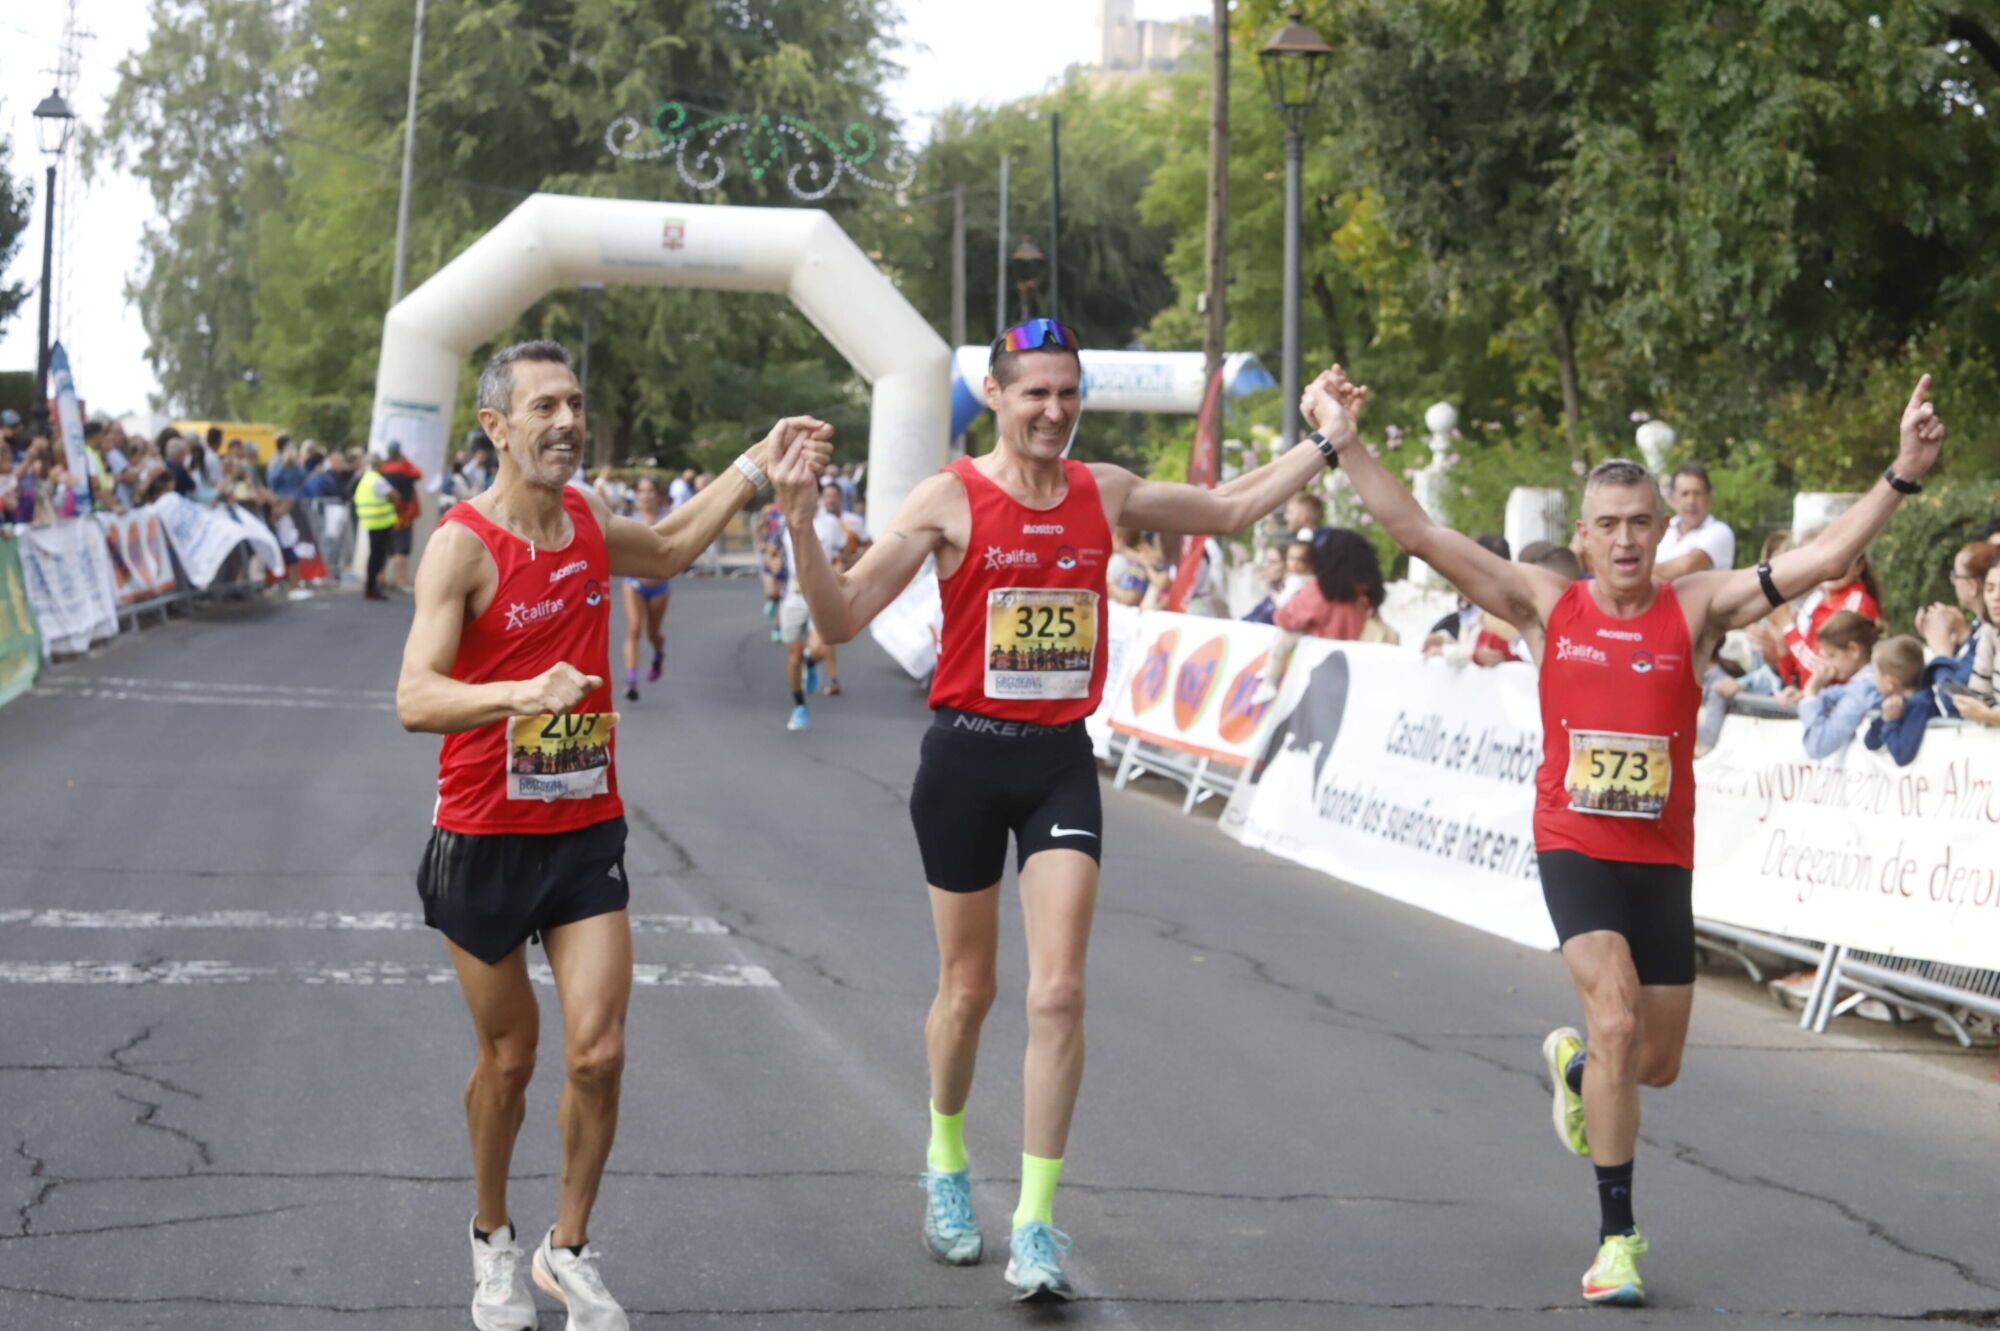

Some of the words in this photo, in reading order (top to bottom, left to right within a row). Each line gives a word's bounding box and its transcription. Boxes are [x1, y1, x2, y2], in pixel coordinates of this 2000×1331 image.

[998, 548, 1038, 564] califas
[521, 599, 564, 622] califas
[1015, 606, 1076, 638] 325
[1567, 643, 1607, 663] califas
[953, 713, 1019, 737] NIKE
[1386, 709, 1446, 764] Castillo
[1446, 721, 1470, 769] de
[1591, 749, 1649, 781] 573
[1899, 768, 1930, 818] de
[1319, 774, 1362, 825] donde
[1359, 786, 1387, 833] los
[1436, 820, 1460, 857] se
[1457, 811, 1520, 871] hacen
[1880, 840, 1918, 897] de
